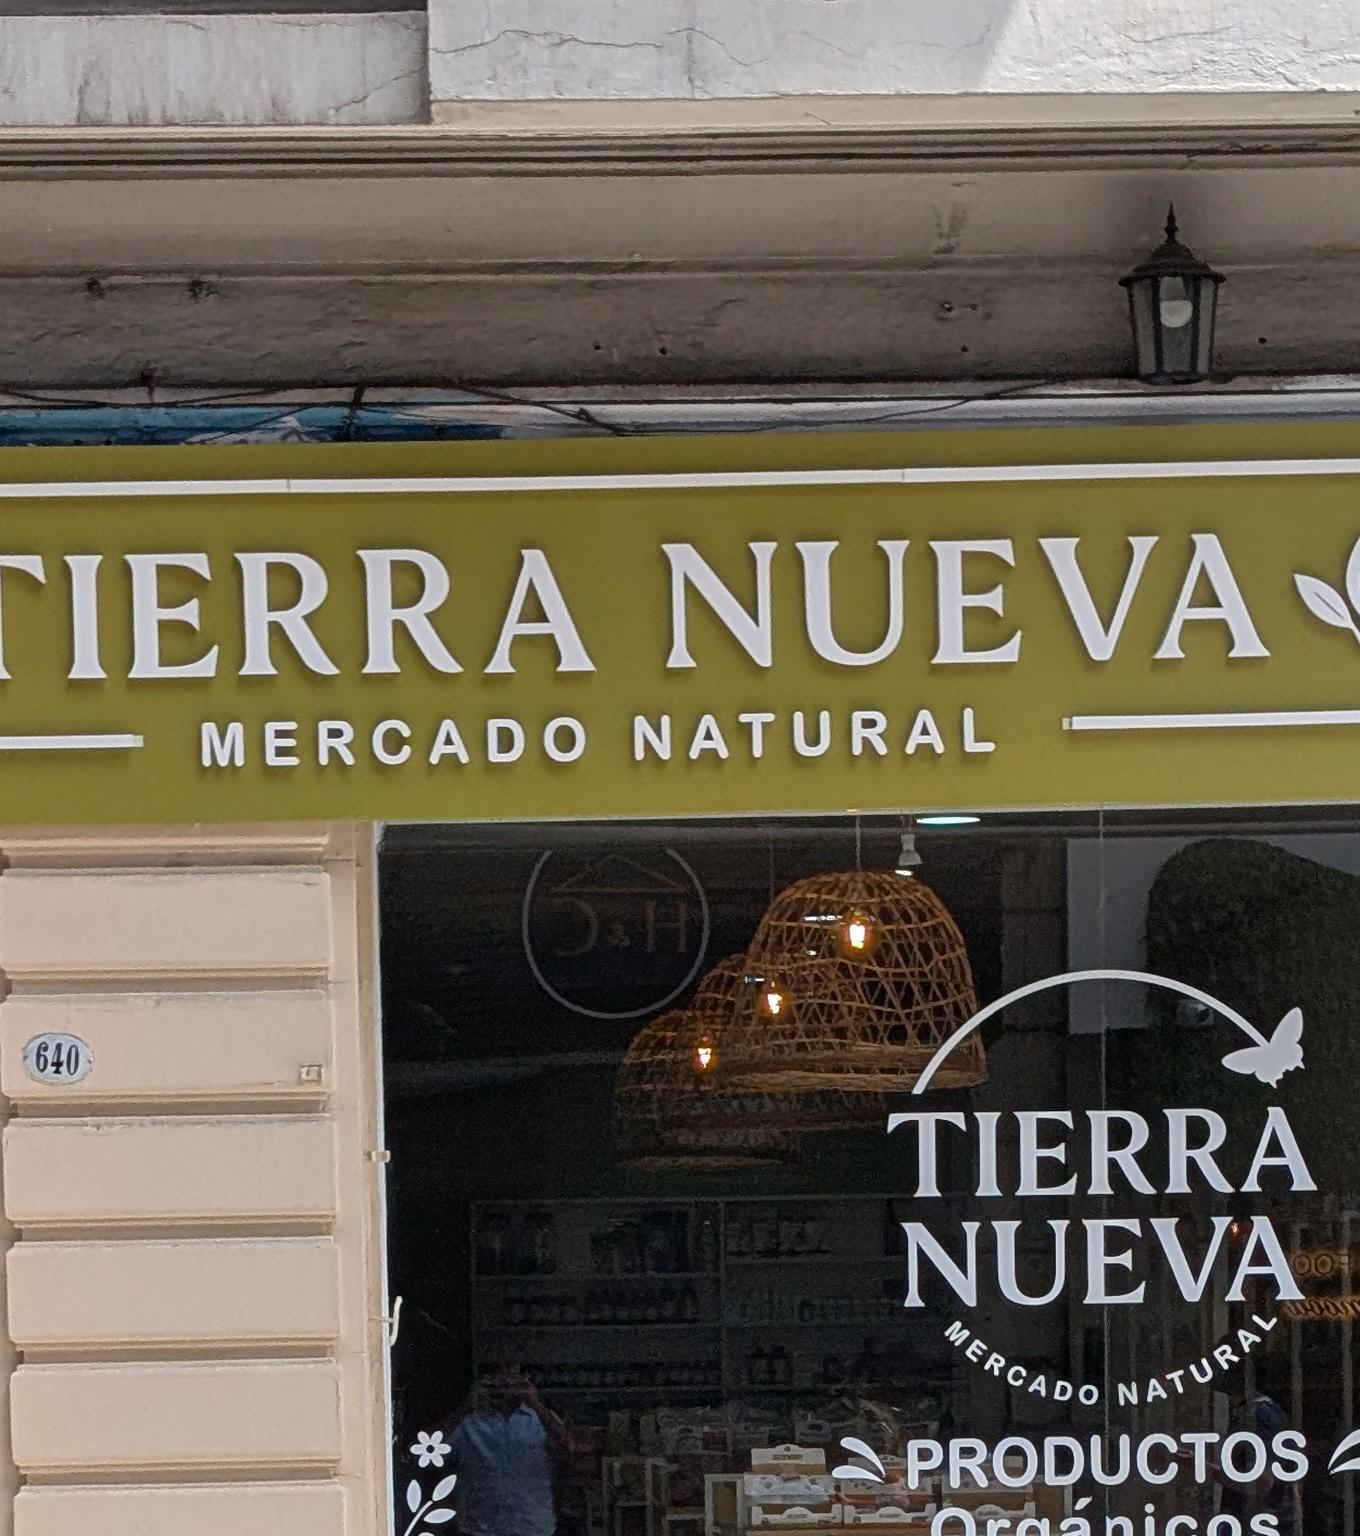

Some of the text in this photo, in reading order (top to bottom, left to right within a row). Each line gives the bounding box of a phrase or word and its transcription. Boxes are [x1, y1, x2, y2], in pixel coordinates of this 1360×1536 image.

[661, 533, 1272, 668] NUEVA
[200, 707, 996, 768] MERCADO NATURAL
[35, 1041, 80, 1076] 640
[887, 1106, 1318, 1198] TIERRA
[900, 1215, 1306, 1308] NUEVA
[943, 1313, 1278, 1407] MERCADO NATURAL
[906, 1430, 1309, 1490] PRODUCTOS
